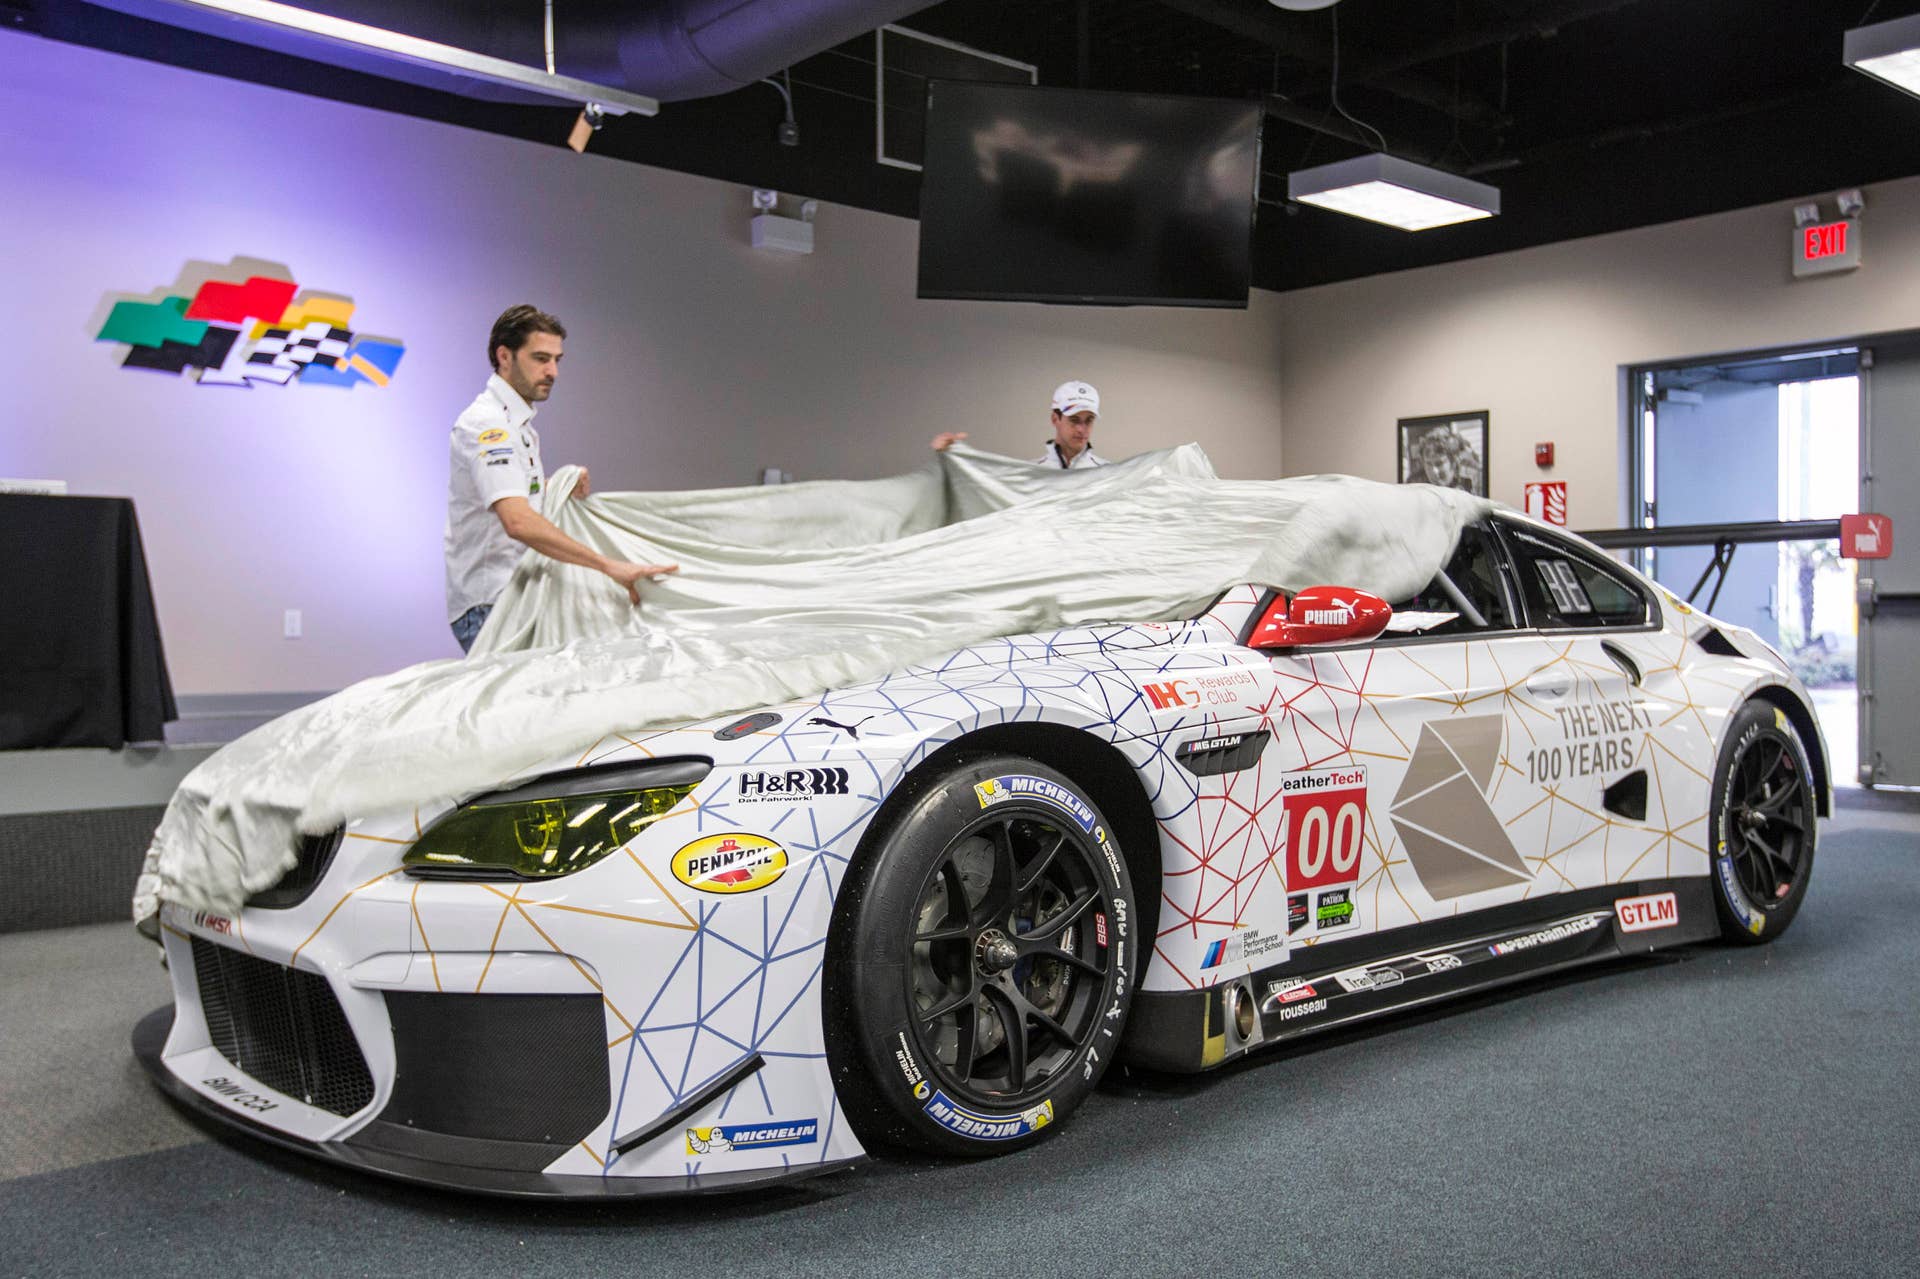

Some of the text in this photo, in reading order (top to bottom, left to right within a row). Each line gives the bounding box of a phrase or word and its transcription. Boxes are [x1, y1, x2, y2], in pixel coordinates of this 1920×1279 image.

[1803, 222, 1848, 260] EXIT
[1305, 609, 1348, 625] PUMA
[1196, 672, 1251, 689] Rewards
[1142, 680, 1200, 709] IHG
[1206, 688, 1238, 705] Club
[1555, 700, 1652, 740] THE NEXT
[1210, 736, 1241, 749] GTLM
[1527, 737, 1634, 784] 100 YEARS
[741, 769, 807, 795] H&R
[1281, 770, 1363, 791] eatherTech
[1011, 778, 1093, 823] MICHELIN
[1621, 899, 1676, 926] GTLM
[1096, 913, 1107, 945] BBS
[1243, 930, 1260, 941] BMW
[1507, 916, 1599, 952] PERFORMANCE
[1243, 934, 1278, 949] Performance
[1243, 946, 1264, 958] Driving
[1425, 956, 1463, 973] AERO
[1269, 978, 1304, 994] LINCOLN
[1280, 998, 1328, 1021] rousseau
[896, 1050, 918, 1085] MICHELIN
[202, 1077, 279, 1112] BMW CCA
[928, 1101, 1022, 1138] MICHELIN
[733, 1125, 816, 1142] MICHELIN
